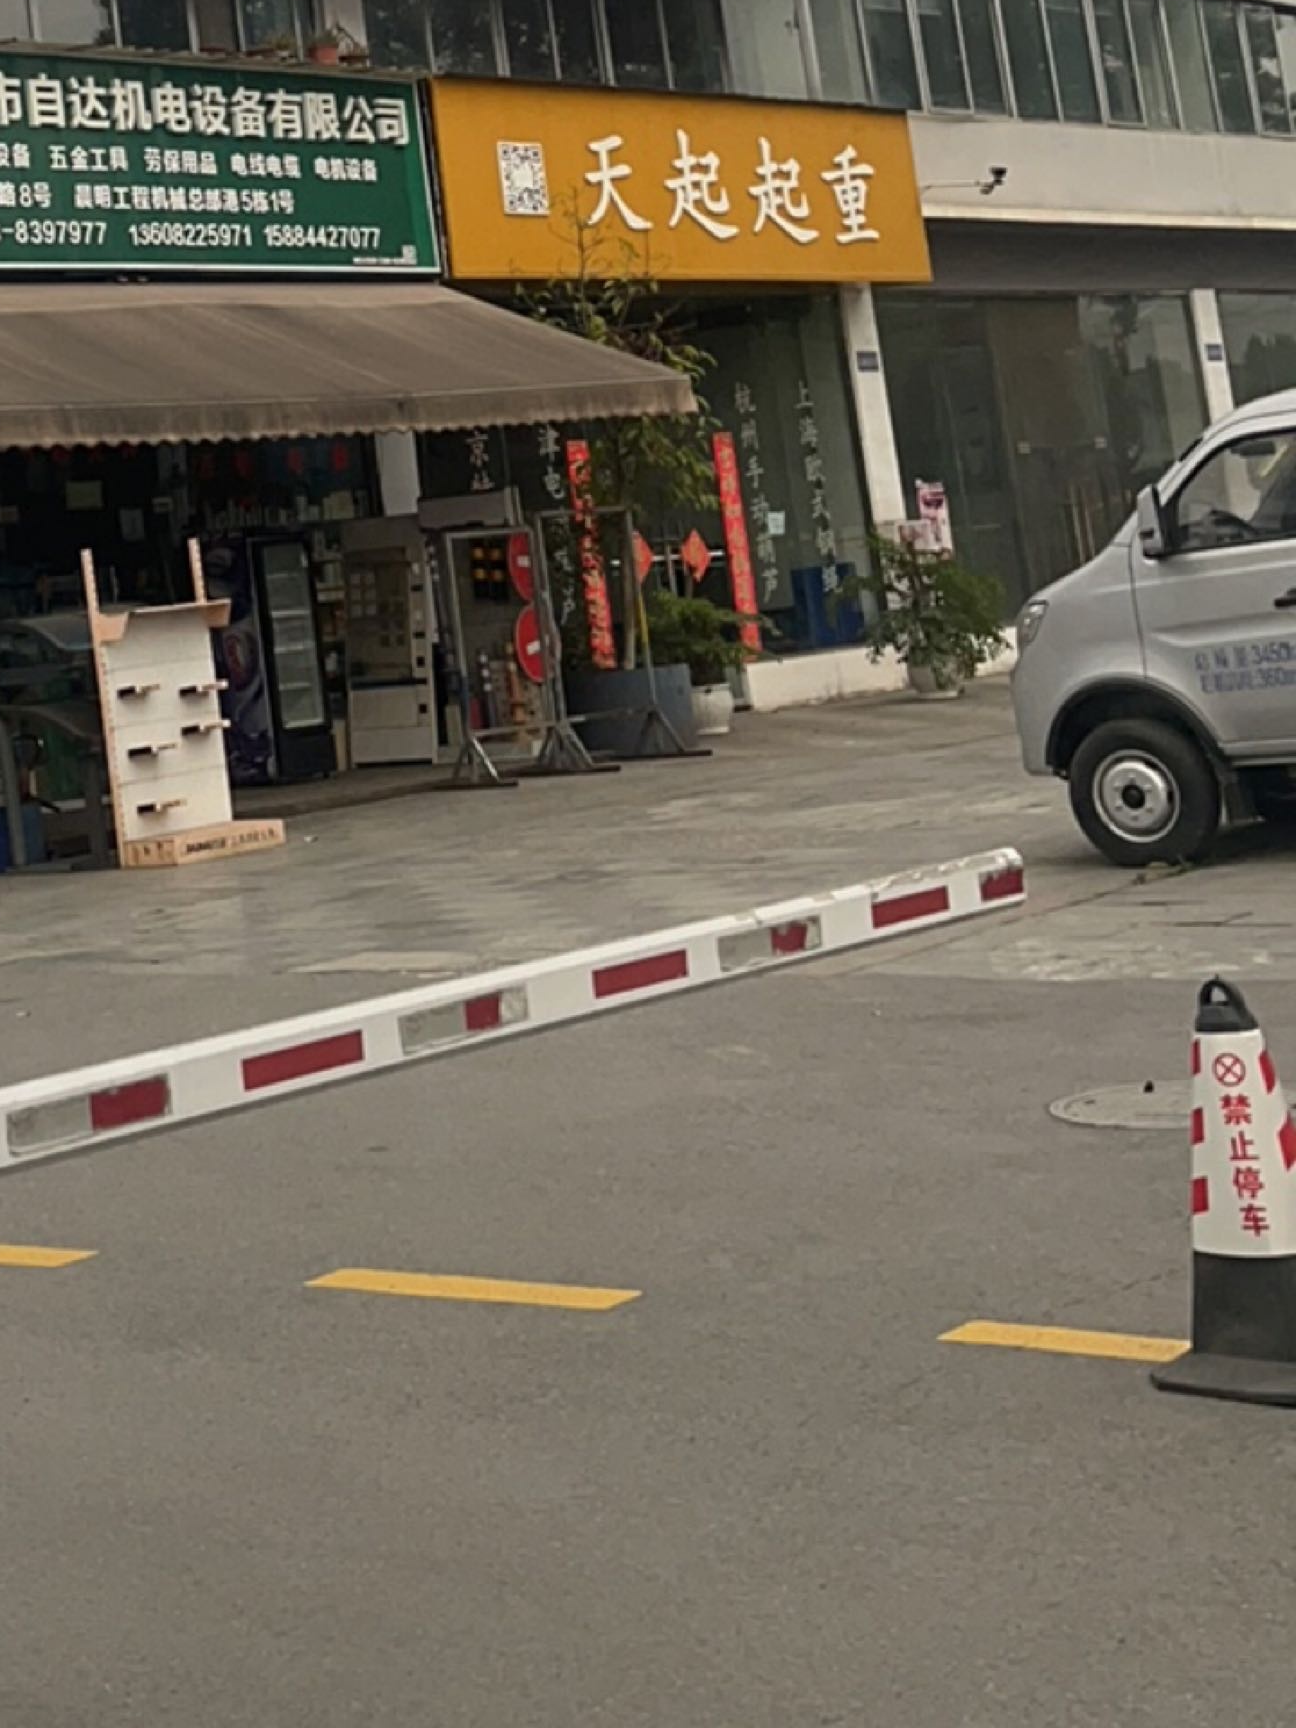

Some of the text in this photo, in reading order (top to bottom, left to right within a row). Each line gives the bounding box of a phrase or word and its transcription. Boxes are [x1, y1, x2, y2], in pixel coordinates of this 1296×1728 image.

[48, 144, 129, 172] 五金工具
[143, 146, 218, 175] 劳保用品
[584, 128, 881, 246] 天起起重
[128, 221, 253, 247] 13608225971
[261, 225, 381, 249] 15884427077
[1220, 1093, 1270, 1237] 禁止停车
